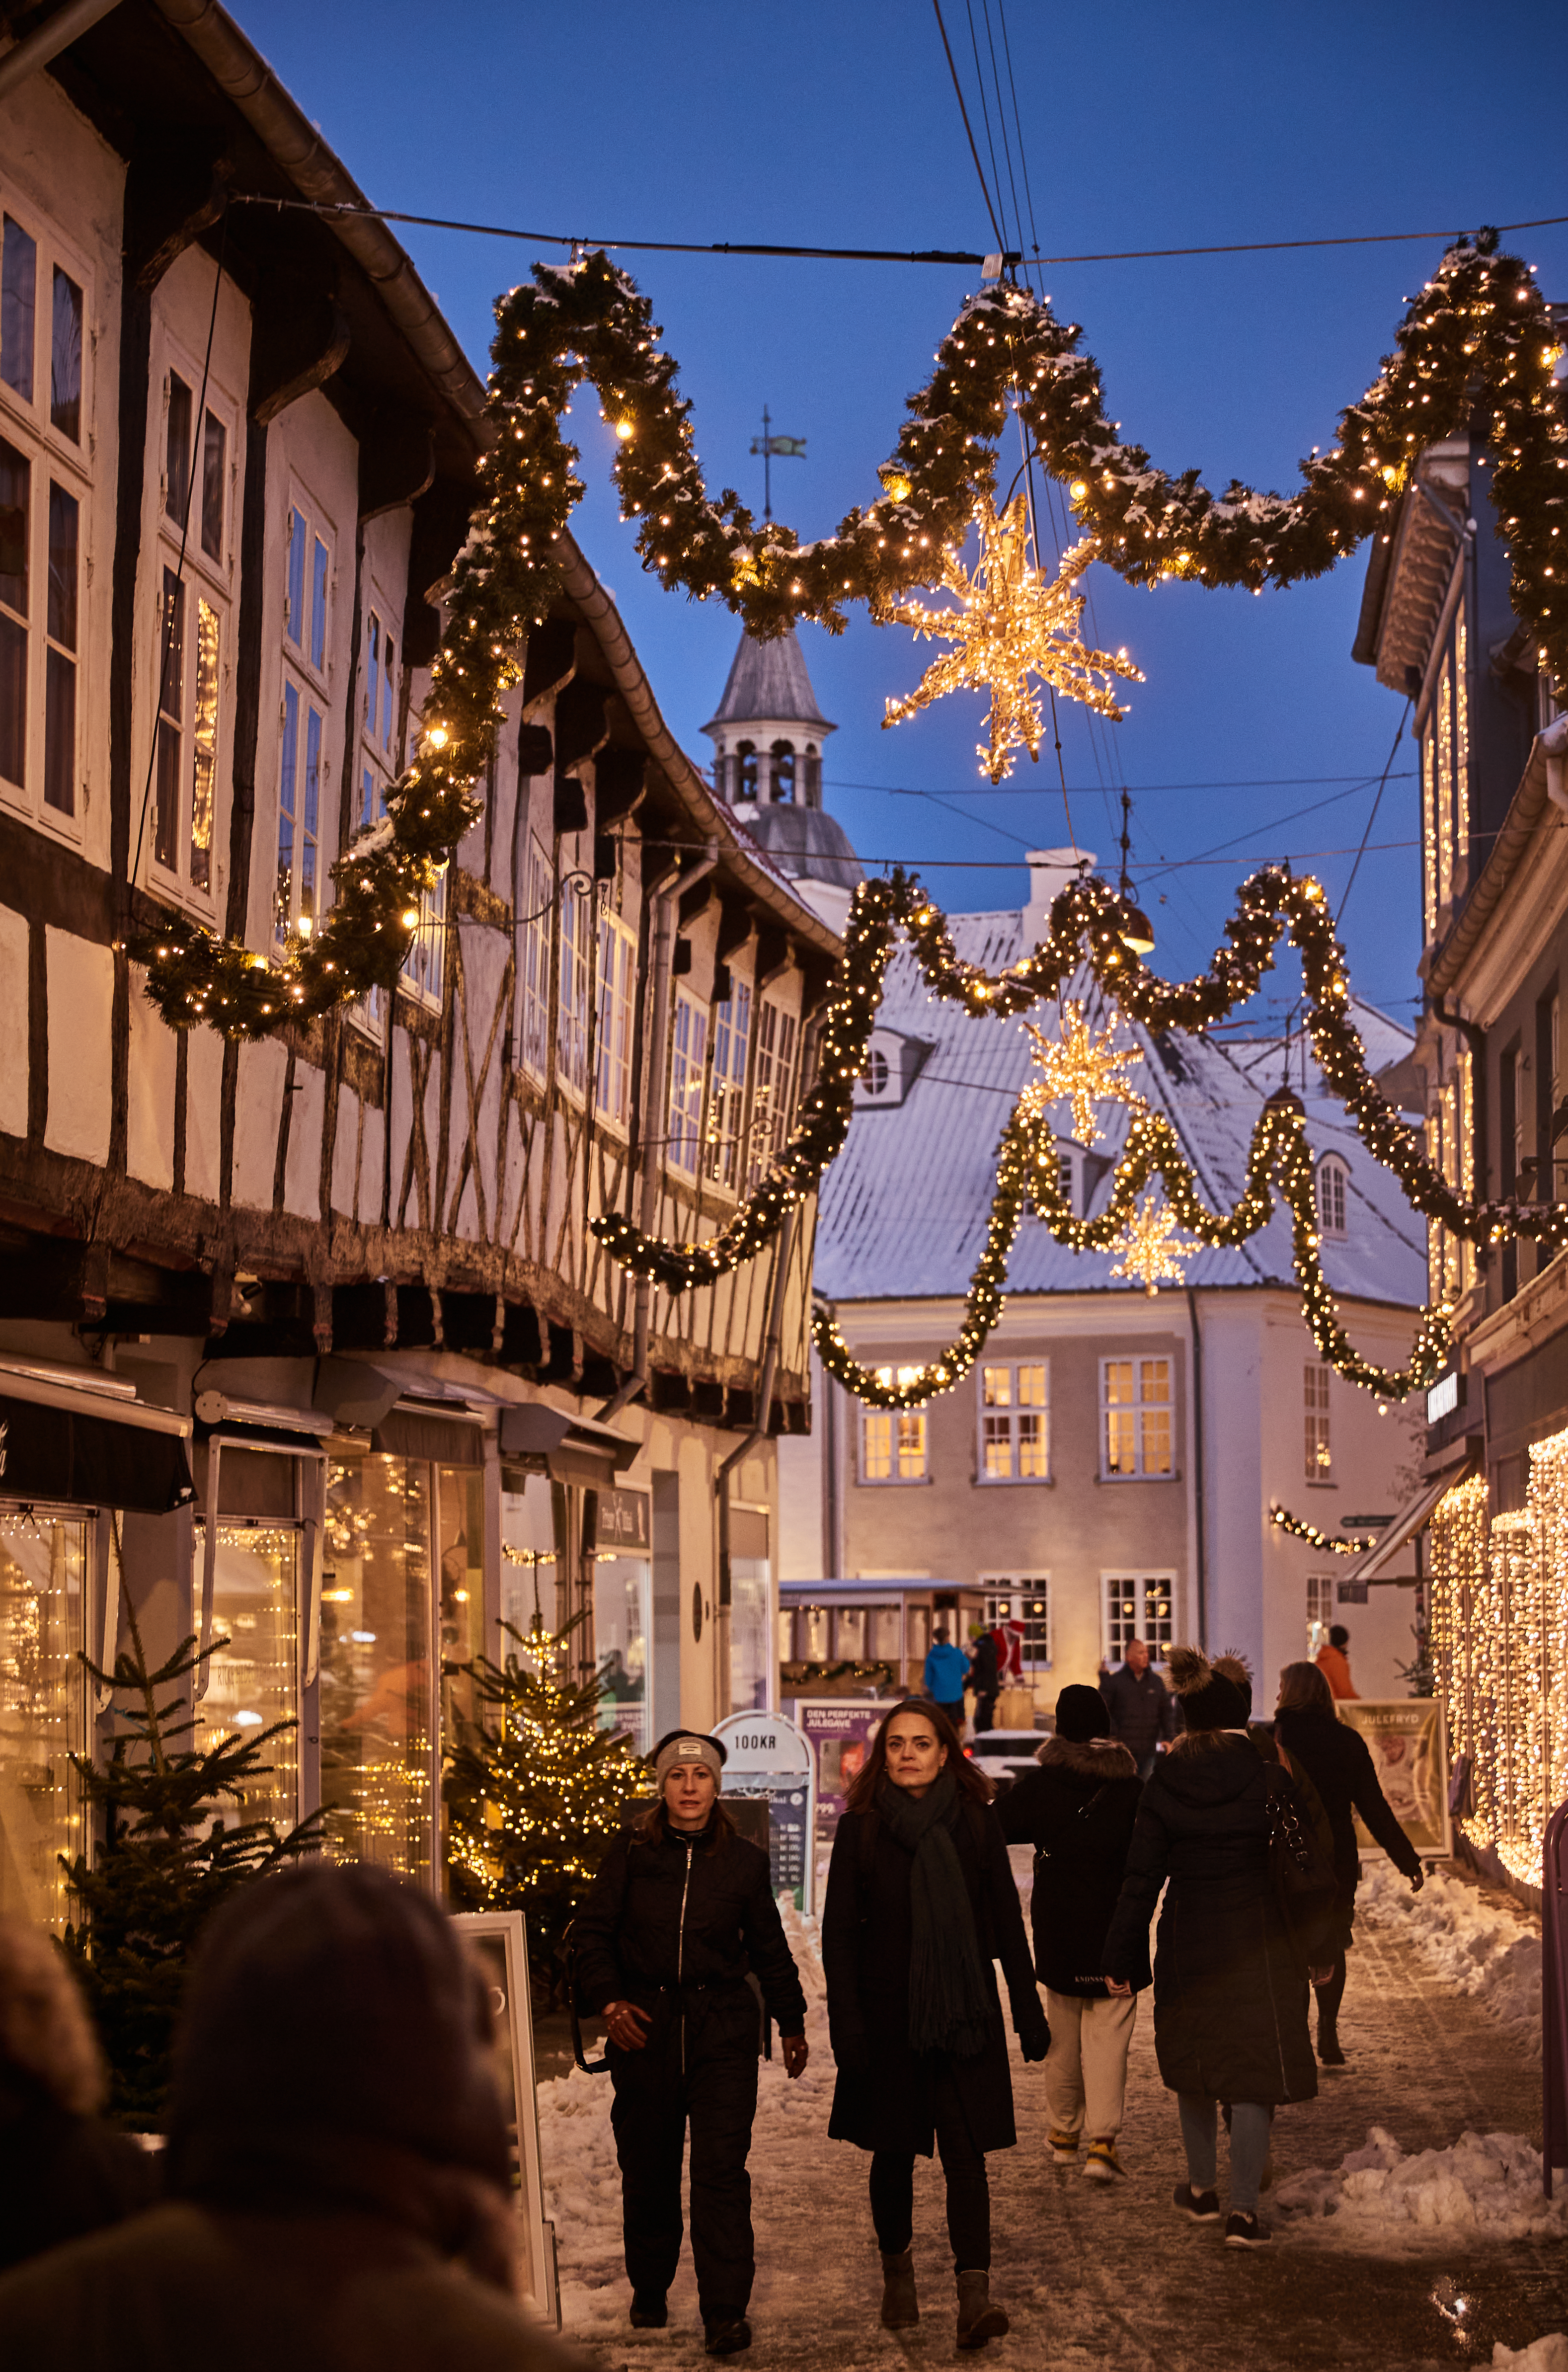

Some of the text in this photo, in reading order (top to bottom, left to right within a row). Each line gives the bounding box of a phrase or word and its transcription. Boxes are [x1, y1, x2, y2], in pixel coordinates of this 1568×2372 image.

[807, 1710, 870, 1719] DEN PERFEKTE
[1361, 1714, 1419, 1725] JULEFRYD
[806, 1719, 851, 1728] JULEGAVE
[735, 1735, 776, 1749] 100KR
